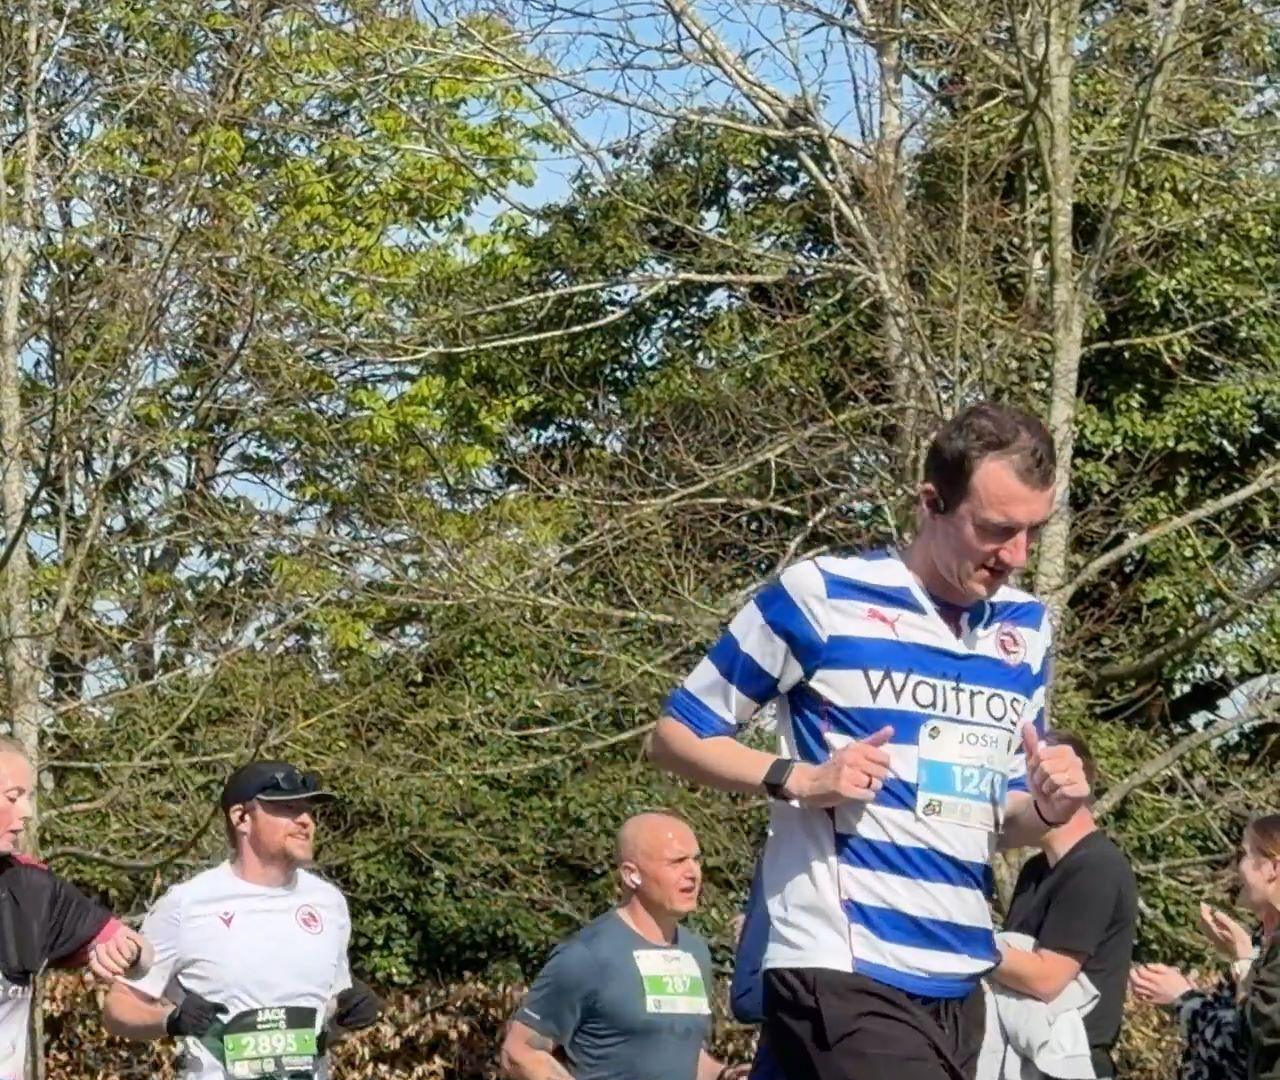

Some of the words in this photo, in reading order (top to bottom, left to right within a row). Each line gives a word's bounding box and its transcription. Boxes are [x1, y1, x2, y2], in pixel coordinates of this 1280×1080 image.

[863, 667, 1028, 727] Waitros
[958, 731, 999, 749] JOSH
[256, 1008, 286, 1022] JACK
[241, 1033, 297, 1057] 2895
